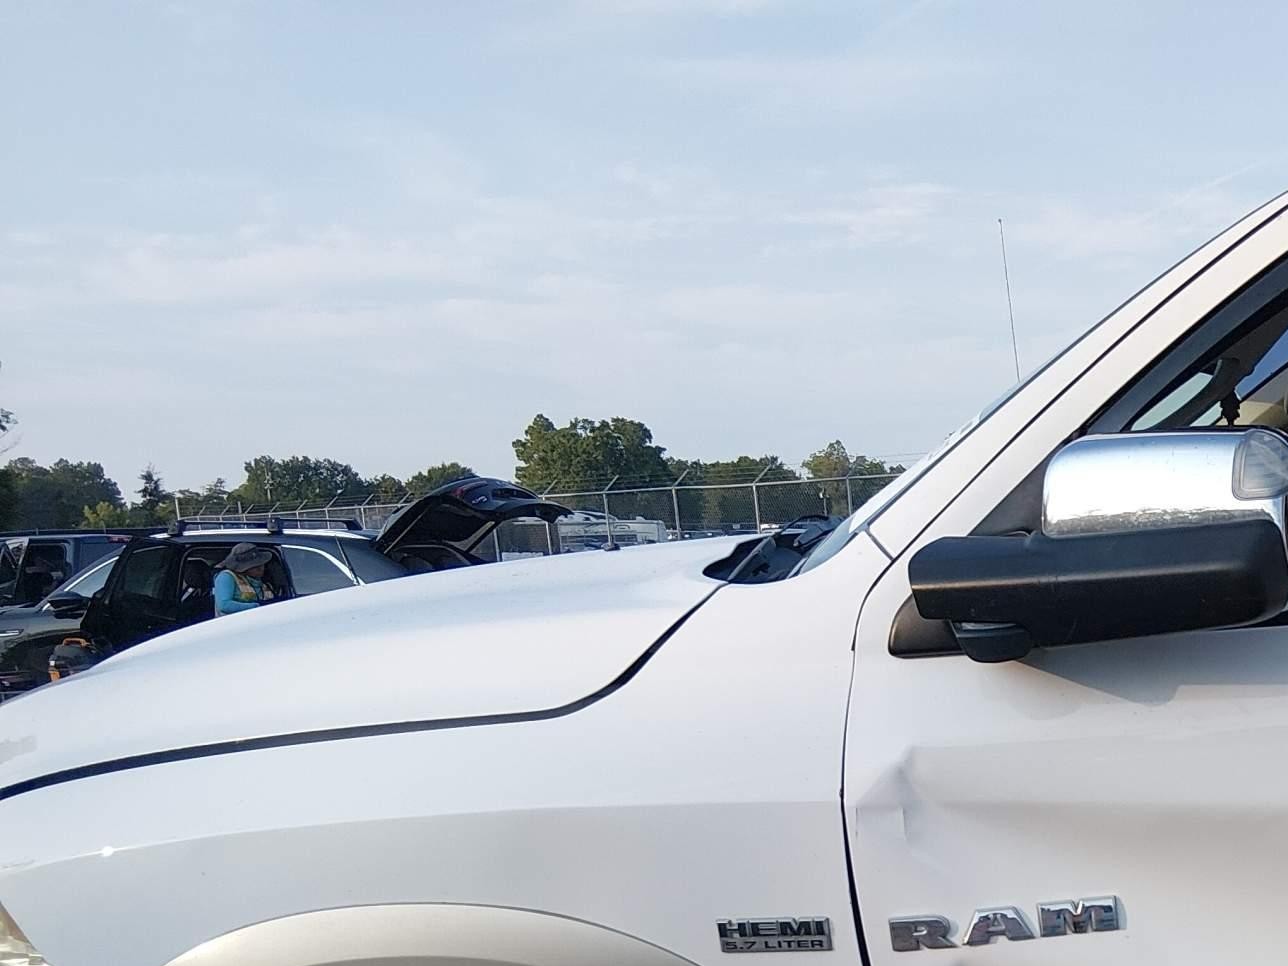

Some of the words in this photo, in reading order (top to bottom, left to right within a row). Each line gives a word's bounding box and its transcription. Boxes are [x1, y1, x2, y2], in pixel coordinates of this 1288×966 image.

[716, 917, 831, 938] HEMI
[889, 896, 1119, 952] RAM
[725, 941, 757, 951] 5.7
[764, 940, 824, 950] LITER
